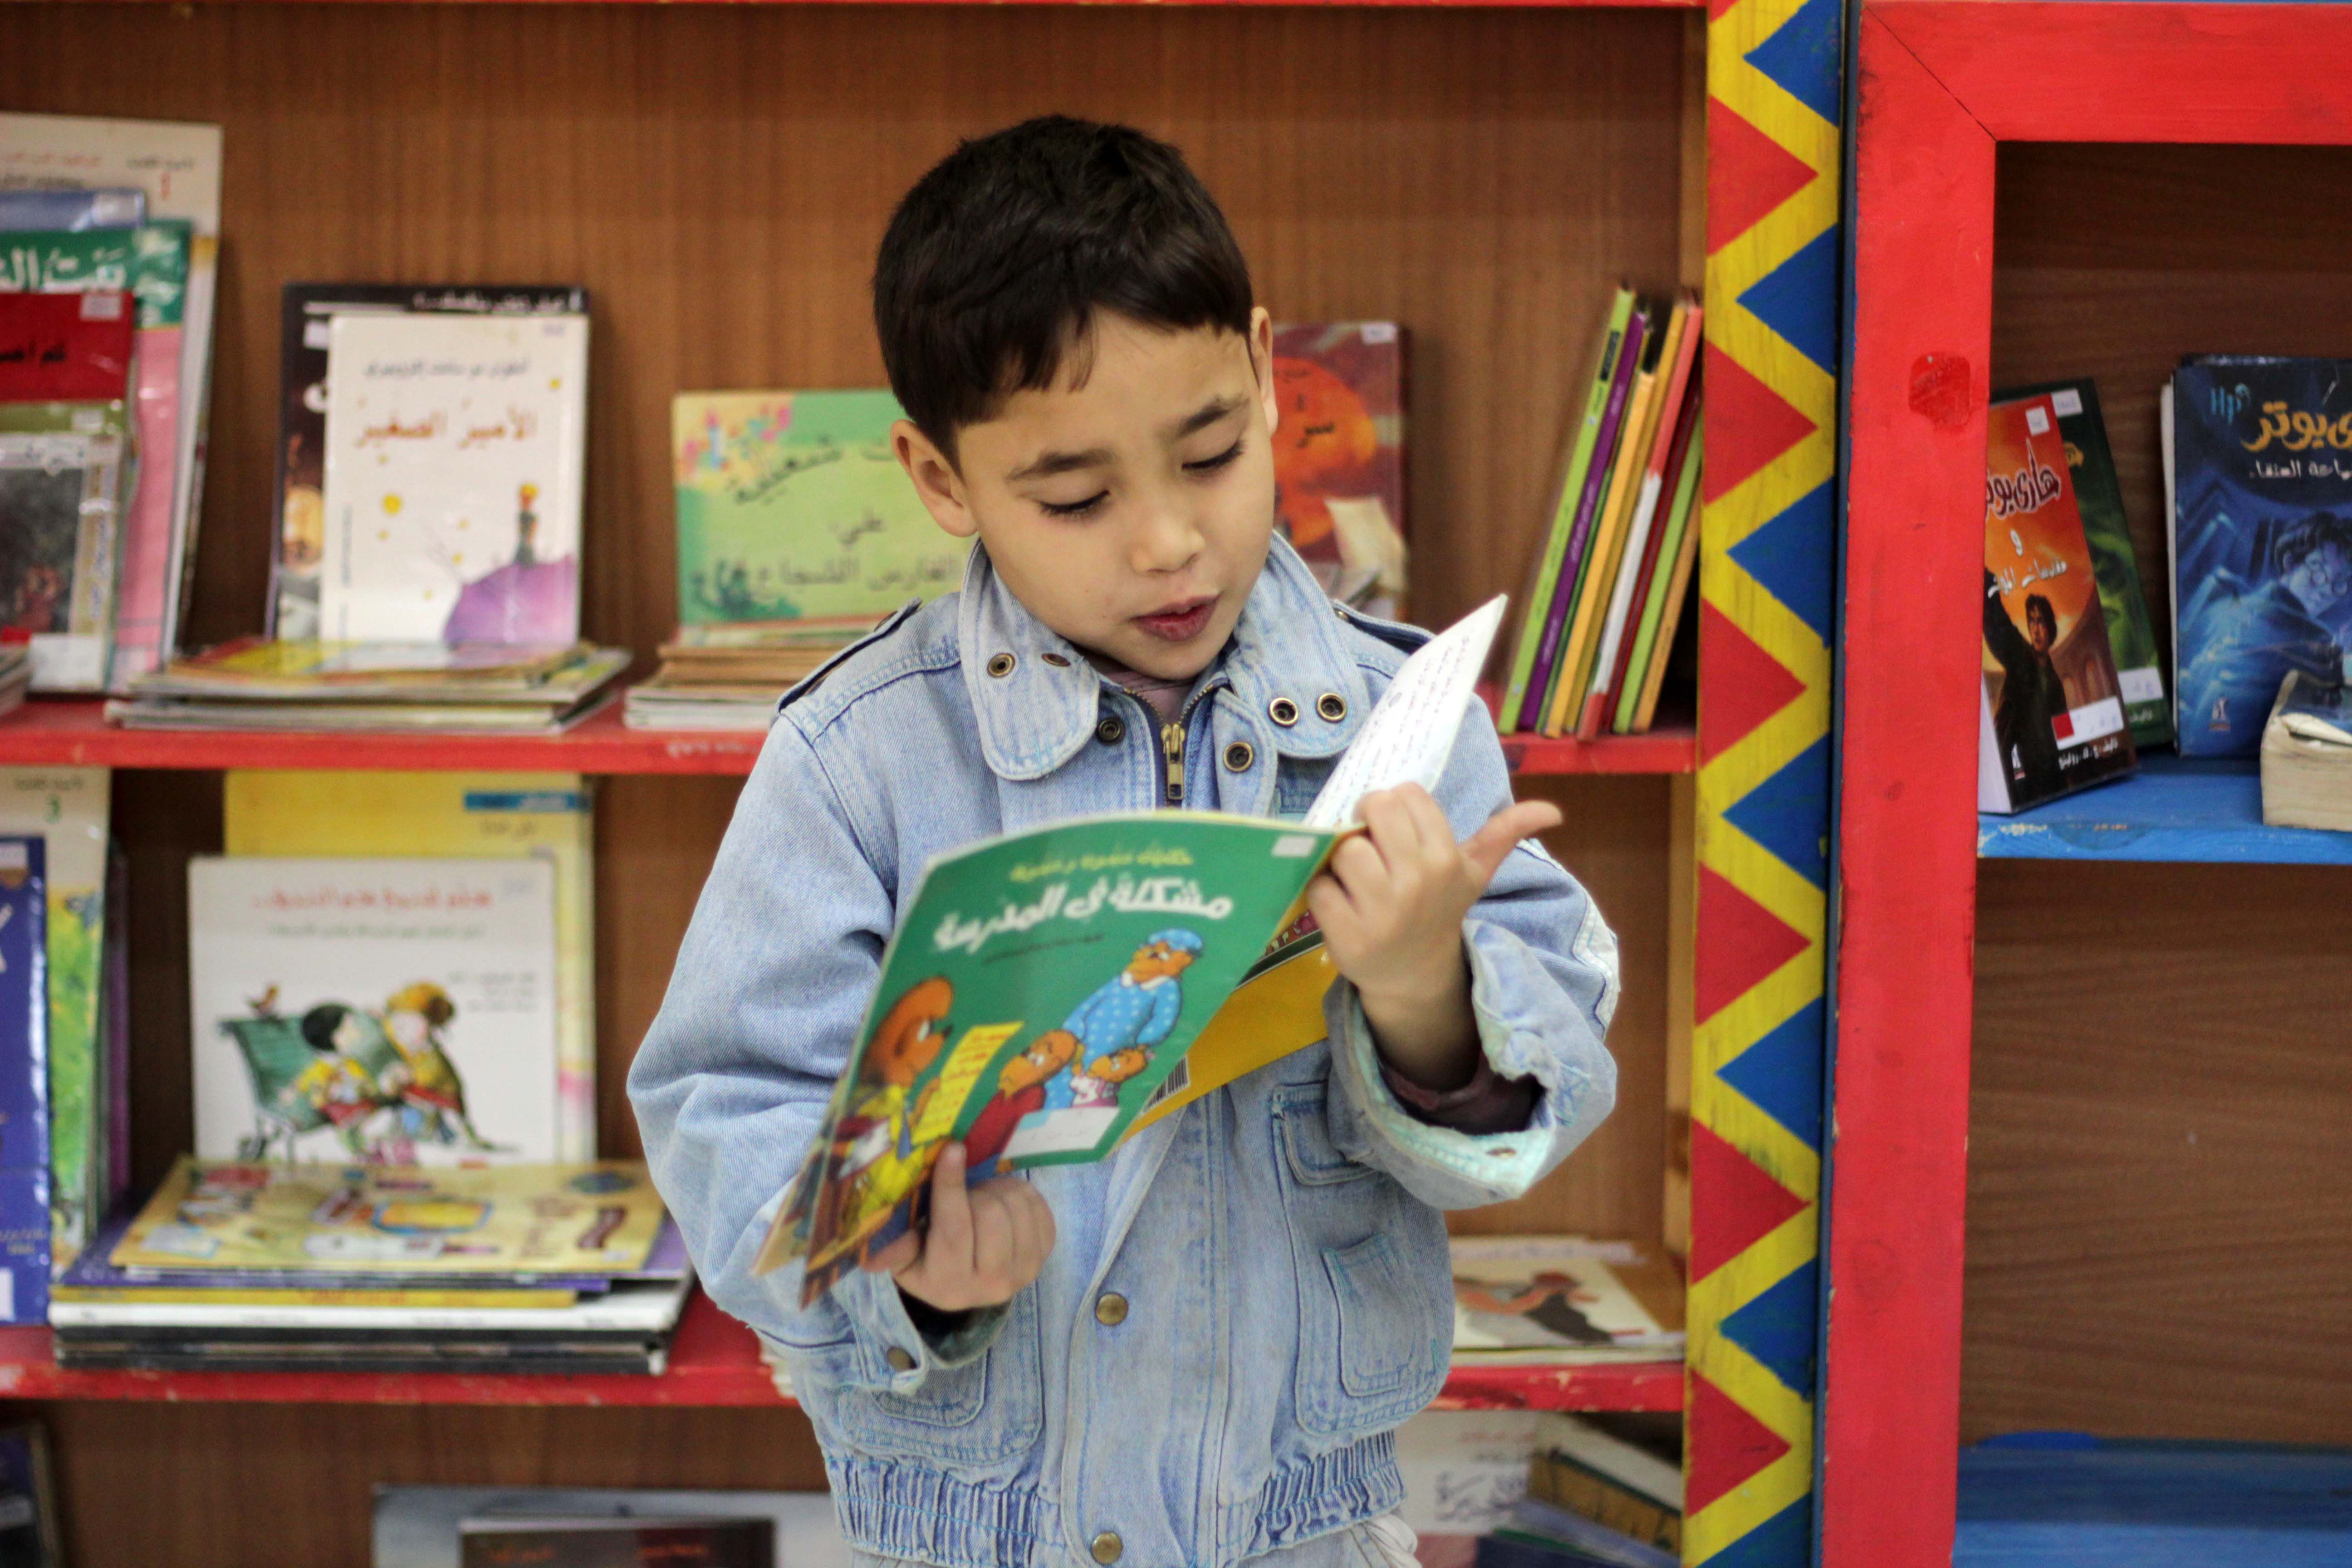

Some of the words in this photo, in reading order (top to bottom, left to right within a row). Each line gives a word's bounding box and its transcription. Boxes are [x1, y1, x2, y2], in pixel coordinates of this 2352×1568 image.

[2240, 401, 2328, 451] بوتر
[2308, 458, 2352, 480] ماعة
[2010, 529, 2023, 557] و
[933, 882, 1068, 954] المدرسة
[1109, 871, 1233, 920] مشكلة
